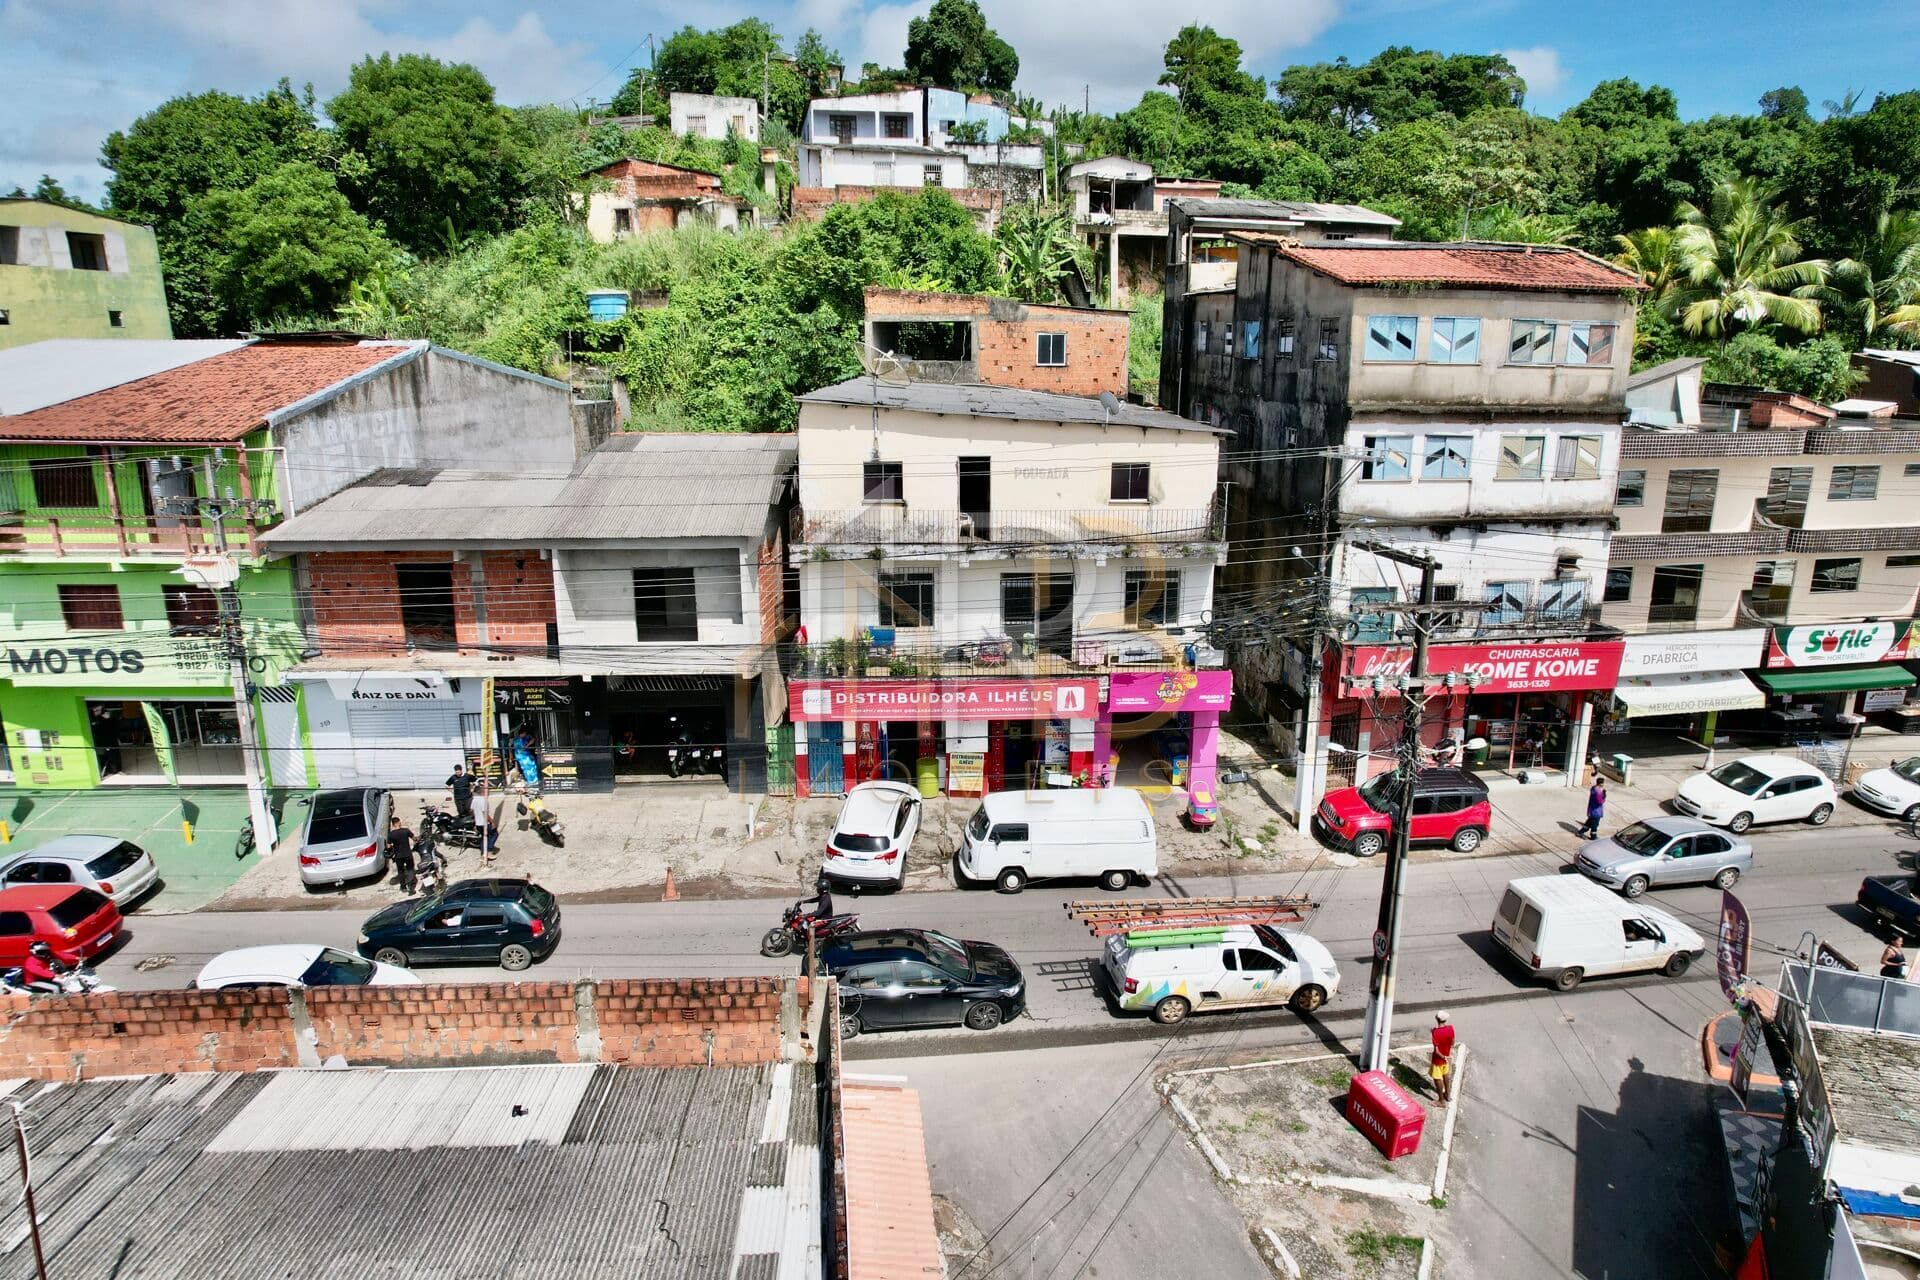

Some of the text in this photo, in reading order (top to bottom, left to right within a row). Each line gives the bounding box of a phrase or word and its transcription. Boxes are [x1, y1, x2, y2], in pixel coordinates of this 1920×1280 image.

[1488, 648, 1580, 660] CHURRASCARIA
[1665, 643, 1698, 651] MERCADO
[7, 648, 145, 673] MOTOS
[1463, 658, 1600, 679] KOME KOME
[1506, 679, 1551, 689] 3633-1326
[351, 690, 383, 699] RAIZ
[835, 691, 979, 704] DISTRIBUIDORA
[988, 688, 1053, 702] ILHÉUS
[1647, 702, 1694, 713] MERCADO
[1369, 1077, 1409, 1111] ITAIPAVA
[1353, 1101, 1388, 1140] ITAIPAVA
